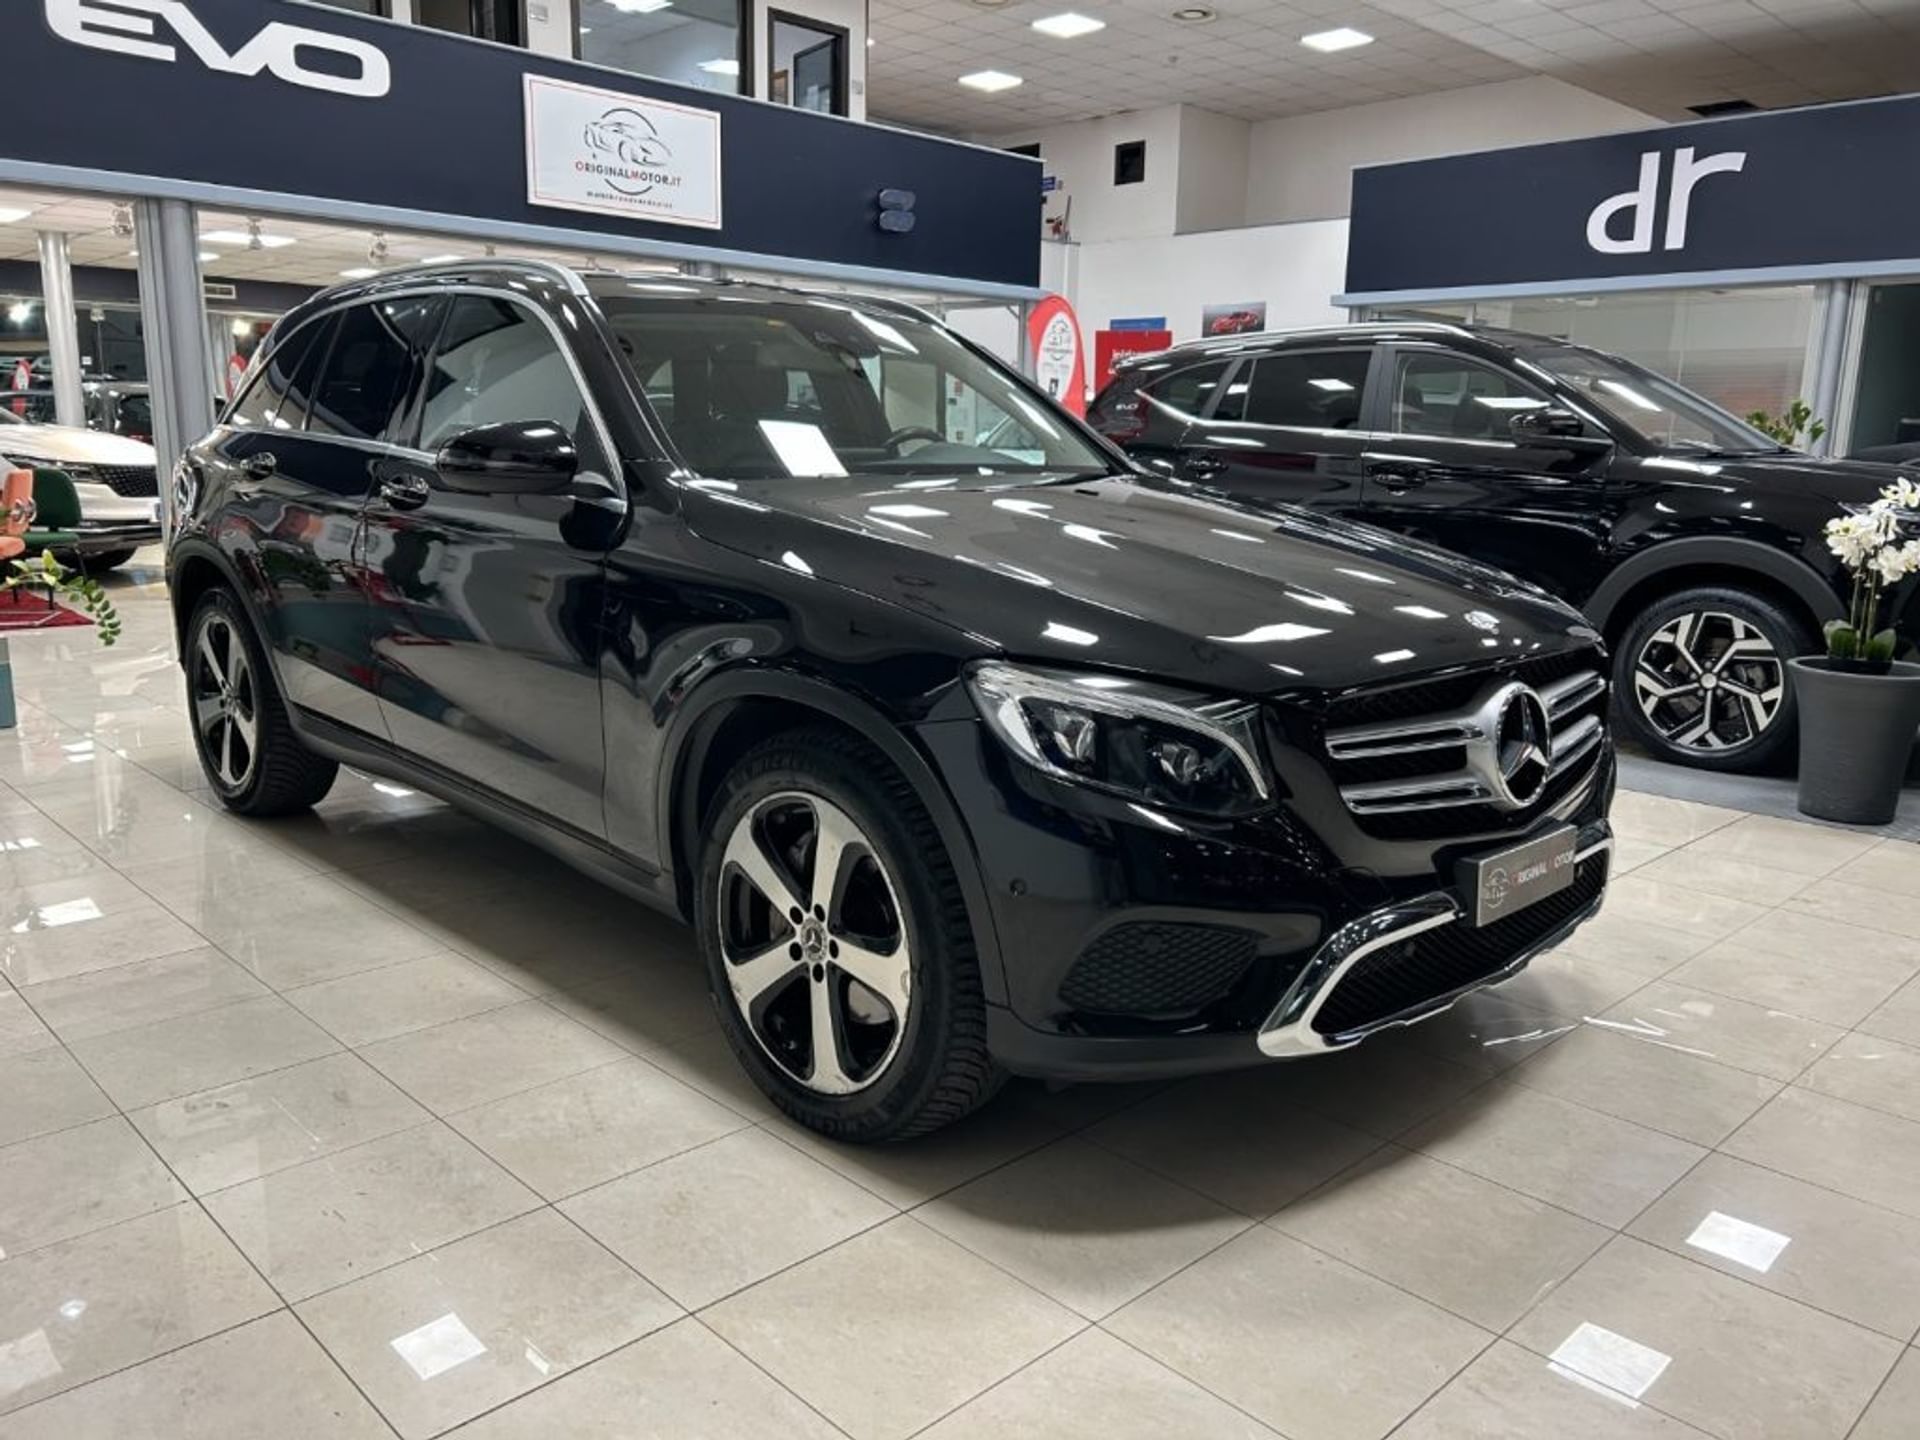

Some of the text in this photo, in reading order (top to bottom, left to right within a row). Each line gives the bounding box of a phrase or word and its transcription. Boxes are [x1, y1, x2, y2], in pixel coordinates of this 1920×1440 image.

[45, 0, 391, 98] EVO
[575, 160, 682, 187] ORIGINALMOTOR.IT
[1586, 146, 1747, 254] dr
